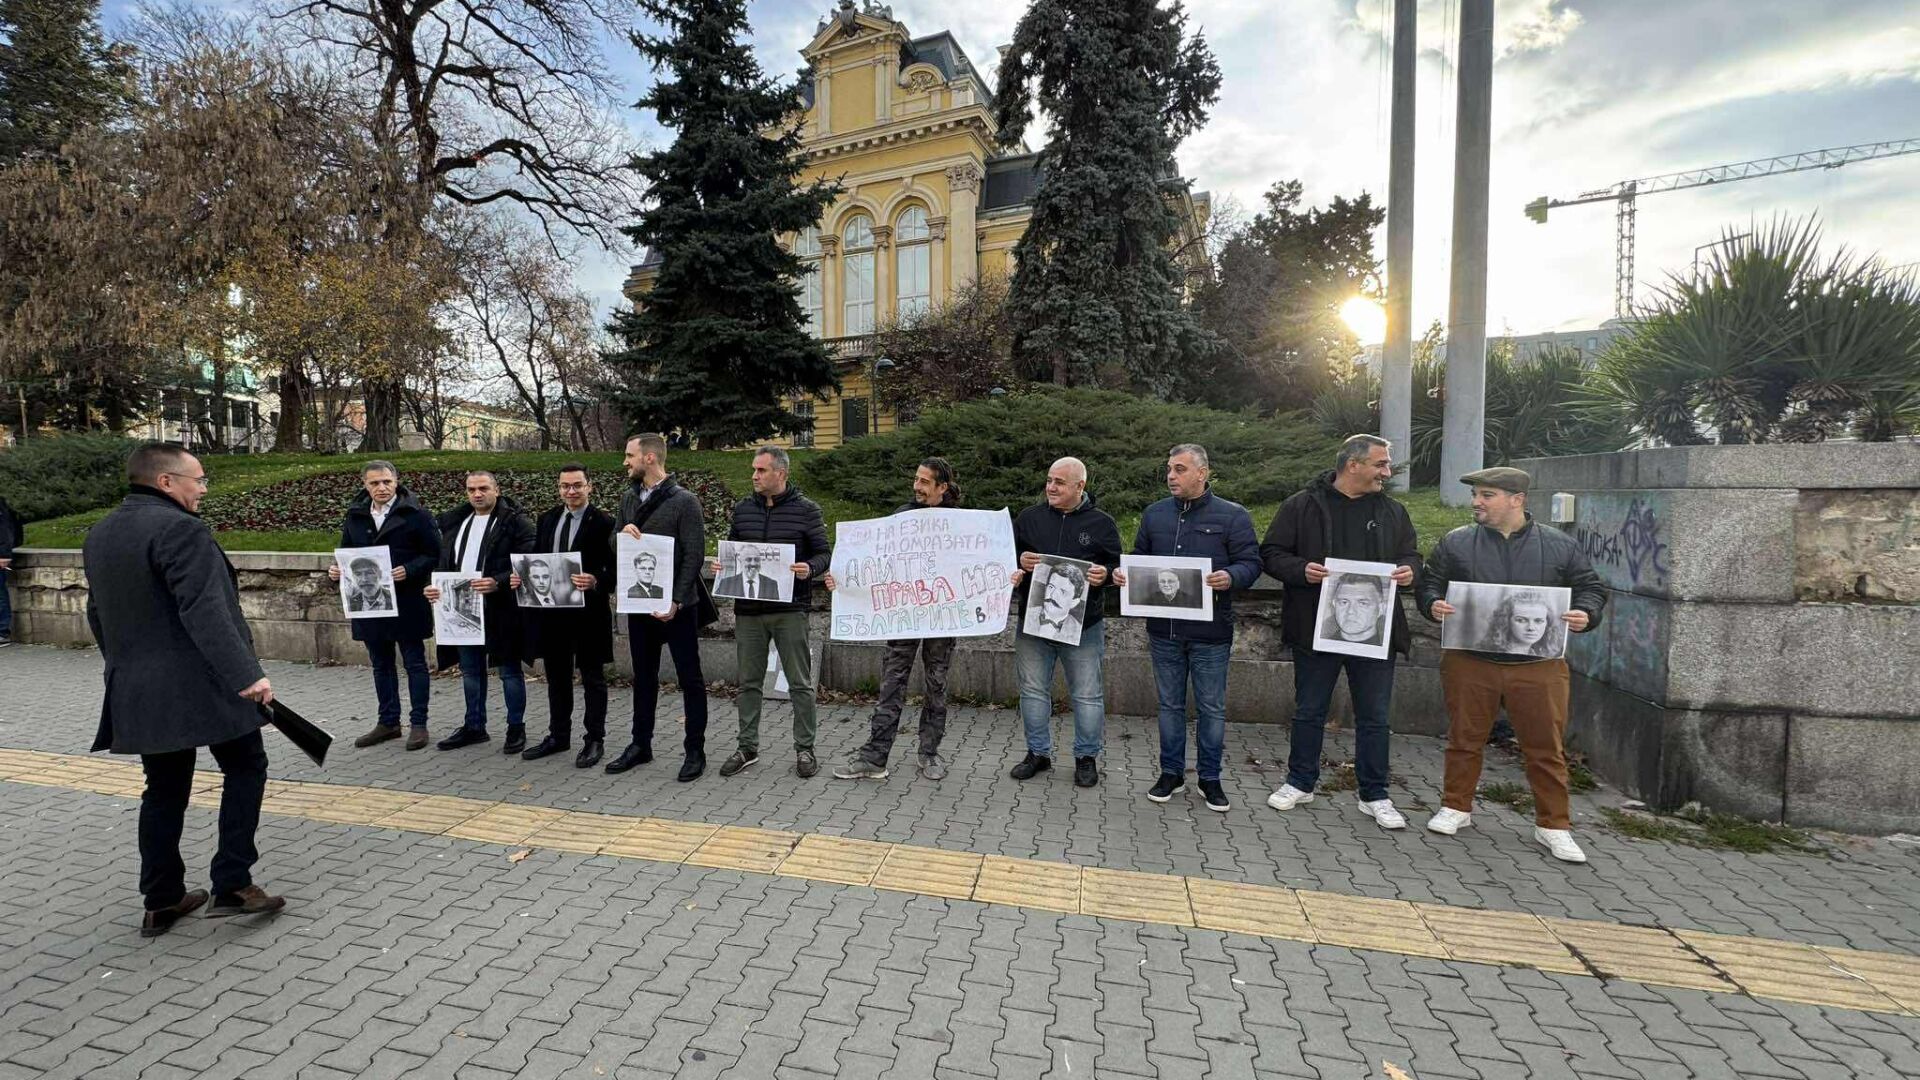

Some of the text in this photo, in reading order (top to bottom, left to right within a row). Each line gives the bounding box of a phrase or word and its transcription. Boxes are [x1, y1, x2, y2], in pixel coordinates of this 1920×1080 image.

[876, 524, 895, 541] НА
[900, 518, 950, 536] ЕЗИКА
[899, 533, 988, 552] ОМРАЗАТА
[871, 576, 955, 611] ПРАВА
[961, 561, 1010, 600] НА
[834, 600, 974, 636] БЪЛГАРИТЕ
